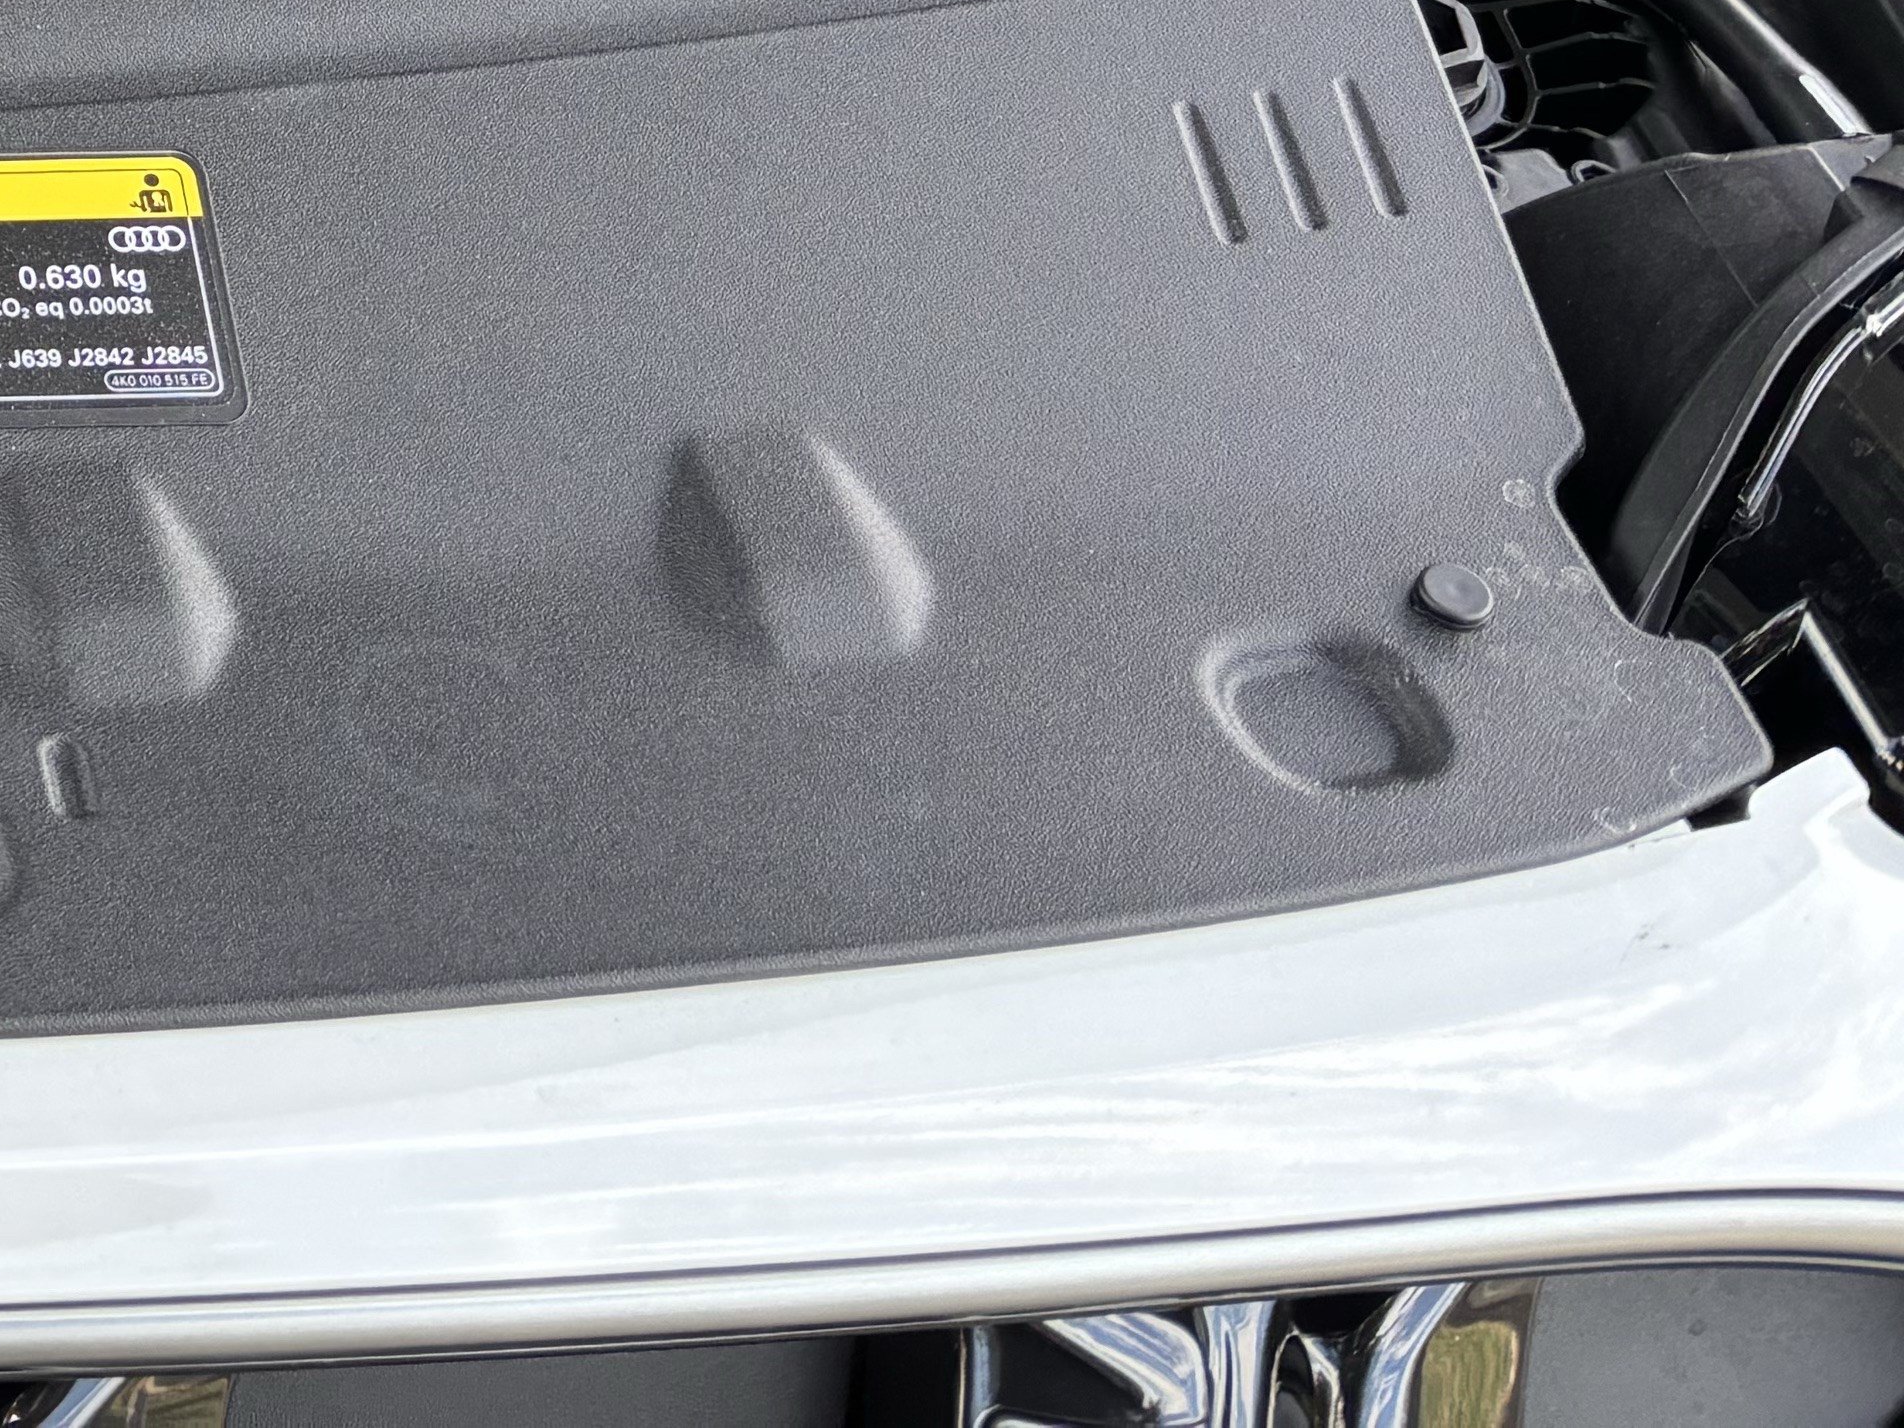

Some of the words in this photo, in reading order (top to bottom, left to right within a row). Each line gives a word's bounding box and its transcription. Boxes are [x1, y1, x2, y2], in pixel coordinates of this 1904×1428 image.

[18, 264, 104, 291] 0.630
[110, 263, 147, 293] kg
[35, 301, 66, 319] eq
[69, 296, 154, 317] 0.0003t
[8, 348, 62, 369] J639
[68, 347, 135, 367] J2842
[141, 344, 209, 366] J2845
[111, 374, 137, 387] 4K0
[139, 374, 162, 387] 010
[164, 374, 188, 386] 515
[192, 373, 208, 385] FE
